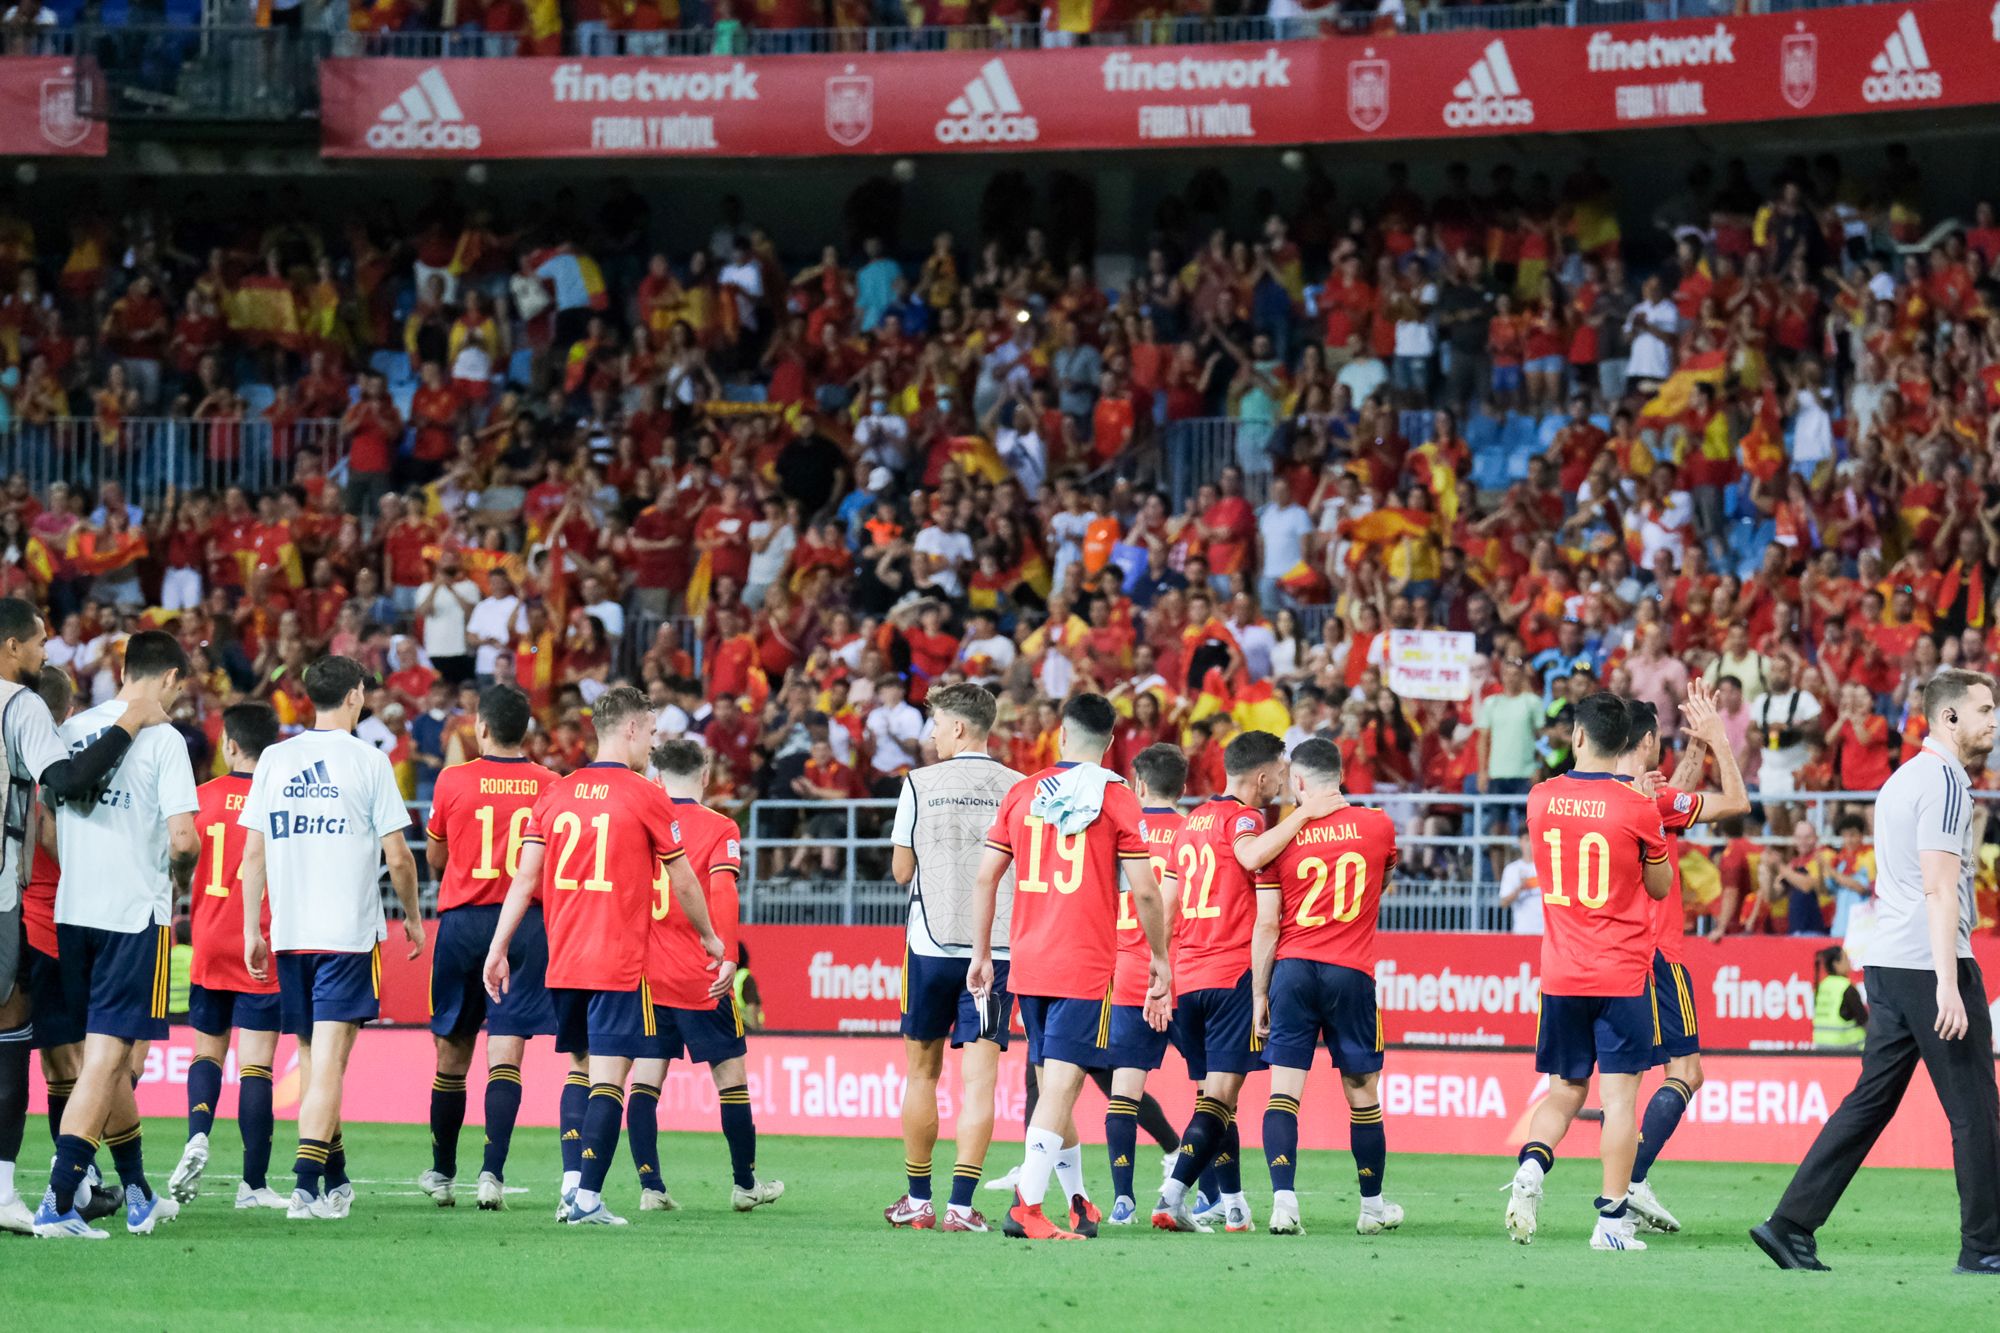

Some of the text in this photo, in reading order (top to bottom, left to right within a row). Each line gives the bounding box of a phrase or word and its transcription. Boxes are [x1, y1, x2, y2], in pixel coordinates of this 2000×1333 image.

[1587, 24, 1735, 73] finetwork
[552, 62, 759, 101] finetwork
[1102, 49, 1290, 91] finetwork
[1863, 71, 1942, 103] adidas
[935, 114, 1039, 144] adidas
[1443, 97, 1534, 128] adidas
[366, 121, 481, 150] adidas
[283, 782, 339, 798] adidas
[480, 777, 538, 796] RODRIGO
[574, 783, 609, 800] OLMO
[928, 798, 950, 807] UEFA
[952, 797, 994, 807] NATIONS
[293, 815, 346, 834] Bitci
[1547, 796, 1606, 819] ASENSIO
[471, 806, 532, 879] 16
[552, 811, 613, 892] 21
[1296, 823, 1362, 847] CARVAJAL
[1018, 815, 1086, 895] 19
[1542, 828, 1611, 910] 10
[1178, 843, 1220, 919] 22
[1296, 851, 1367, 927] 20
[808, 952, 901, 999] finetw
[1374, 959, 1541, 1014] finetwork
[781, 1054, 908, 1118] Talent
